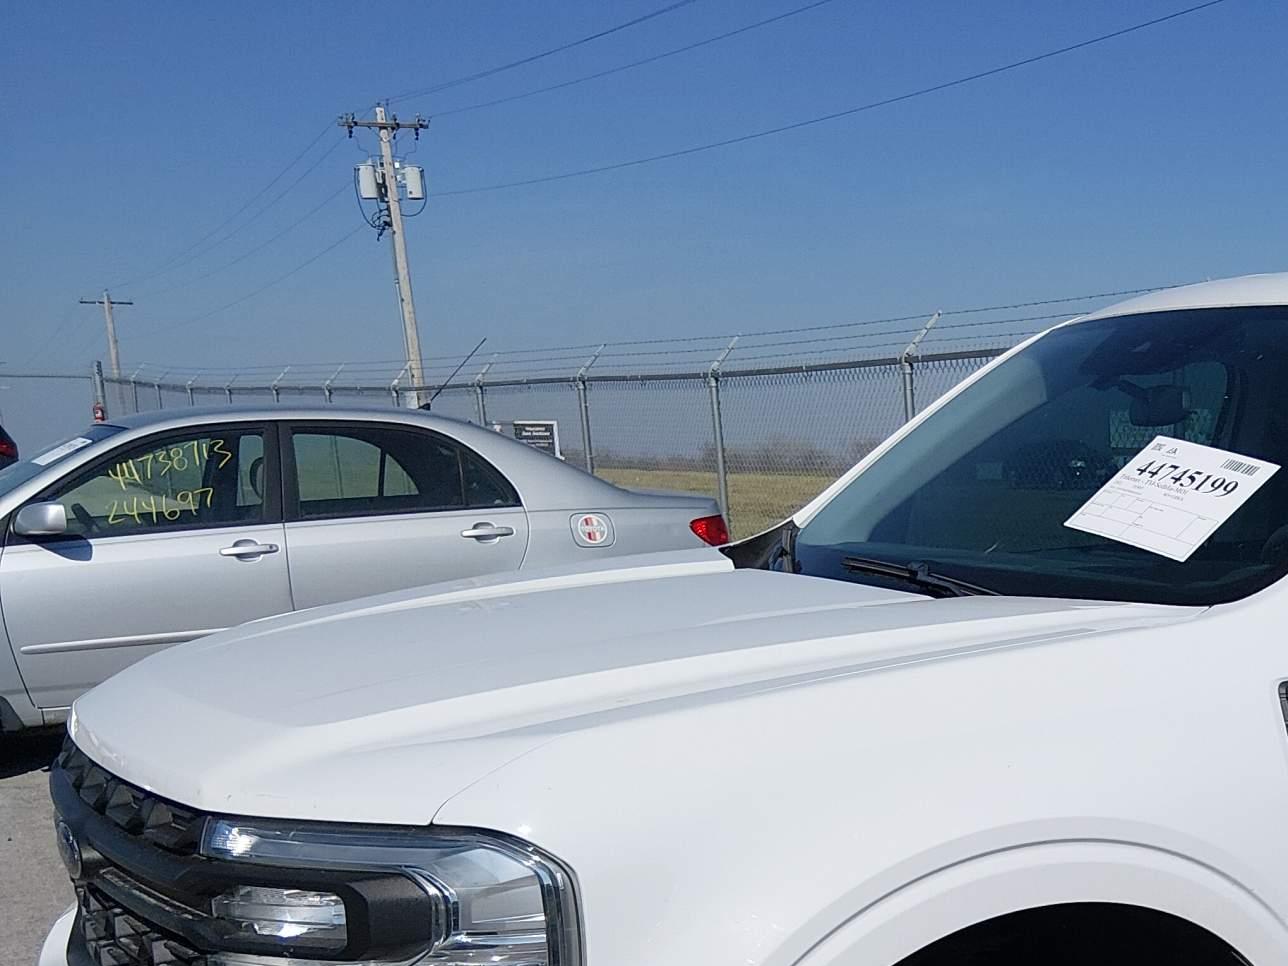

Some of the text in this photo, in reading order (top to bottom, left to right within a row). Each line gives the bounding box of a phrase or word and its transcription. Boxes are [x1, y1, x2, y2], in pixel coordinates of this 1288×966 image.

[108, 439, 232, 490] 44738713
[1136, 460, 1239, 497] 44745199
[108, 487, 213, 524] 244697
